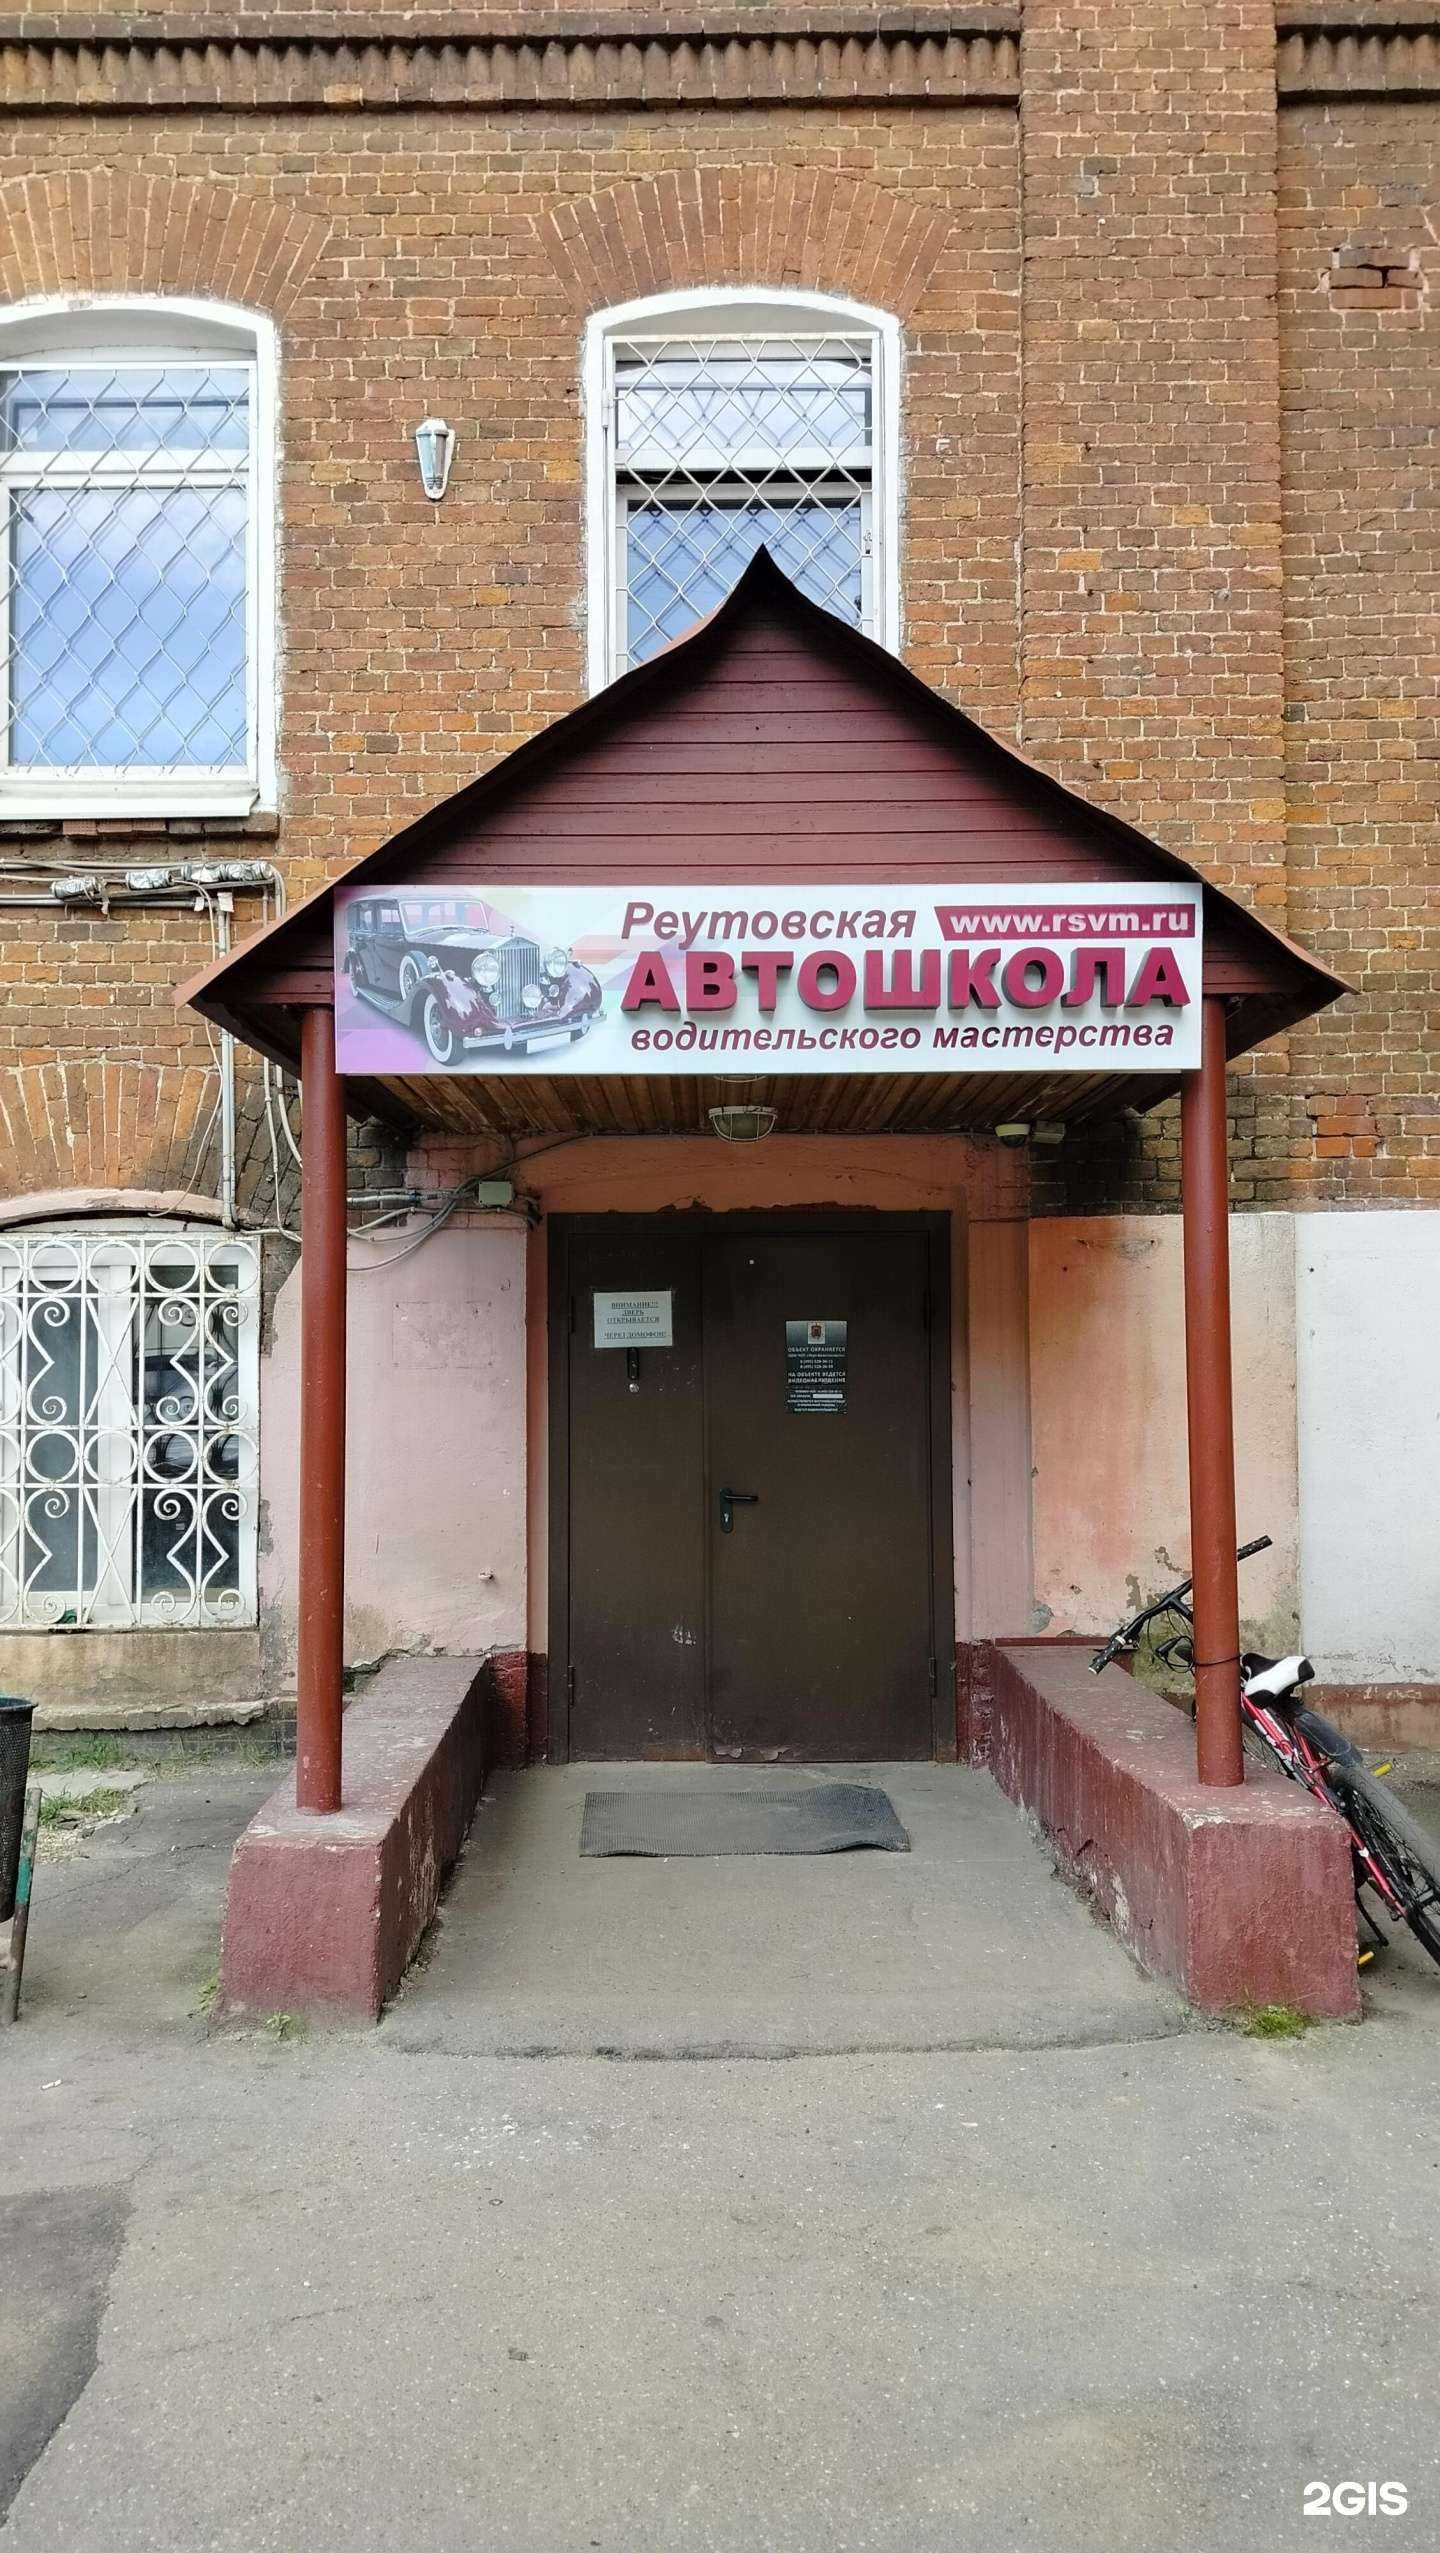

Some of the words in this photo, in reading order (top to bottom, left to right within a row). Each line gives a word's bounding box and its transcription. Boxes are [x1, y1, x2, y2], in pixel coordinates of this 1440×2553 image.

[621, 901, 917, 950] Реутовская
[952, 909, 1190, 935] www.rsvm.ru
[620, 946, 1191, 1013] АВТОШКОЛА
[631, 1021, 921, 1052] водительского
[932, 1023, 1175, 1054] мастерства
